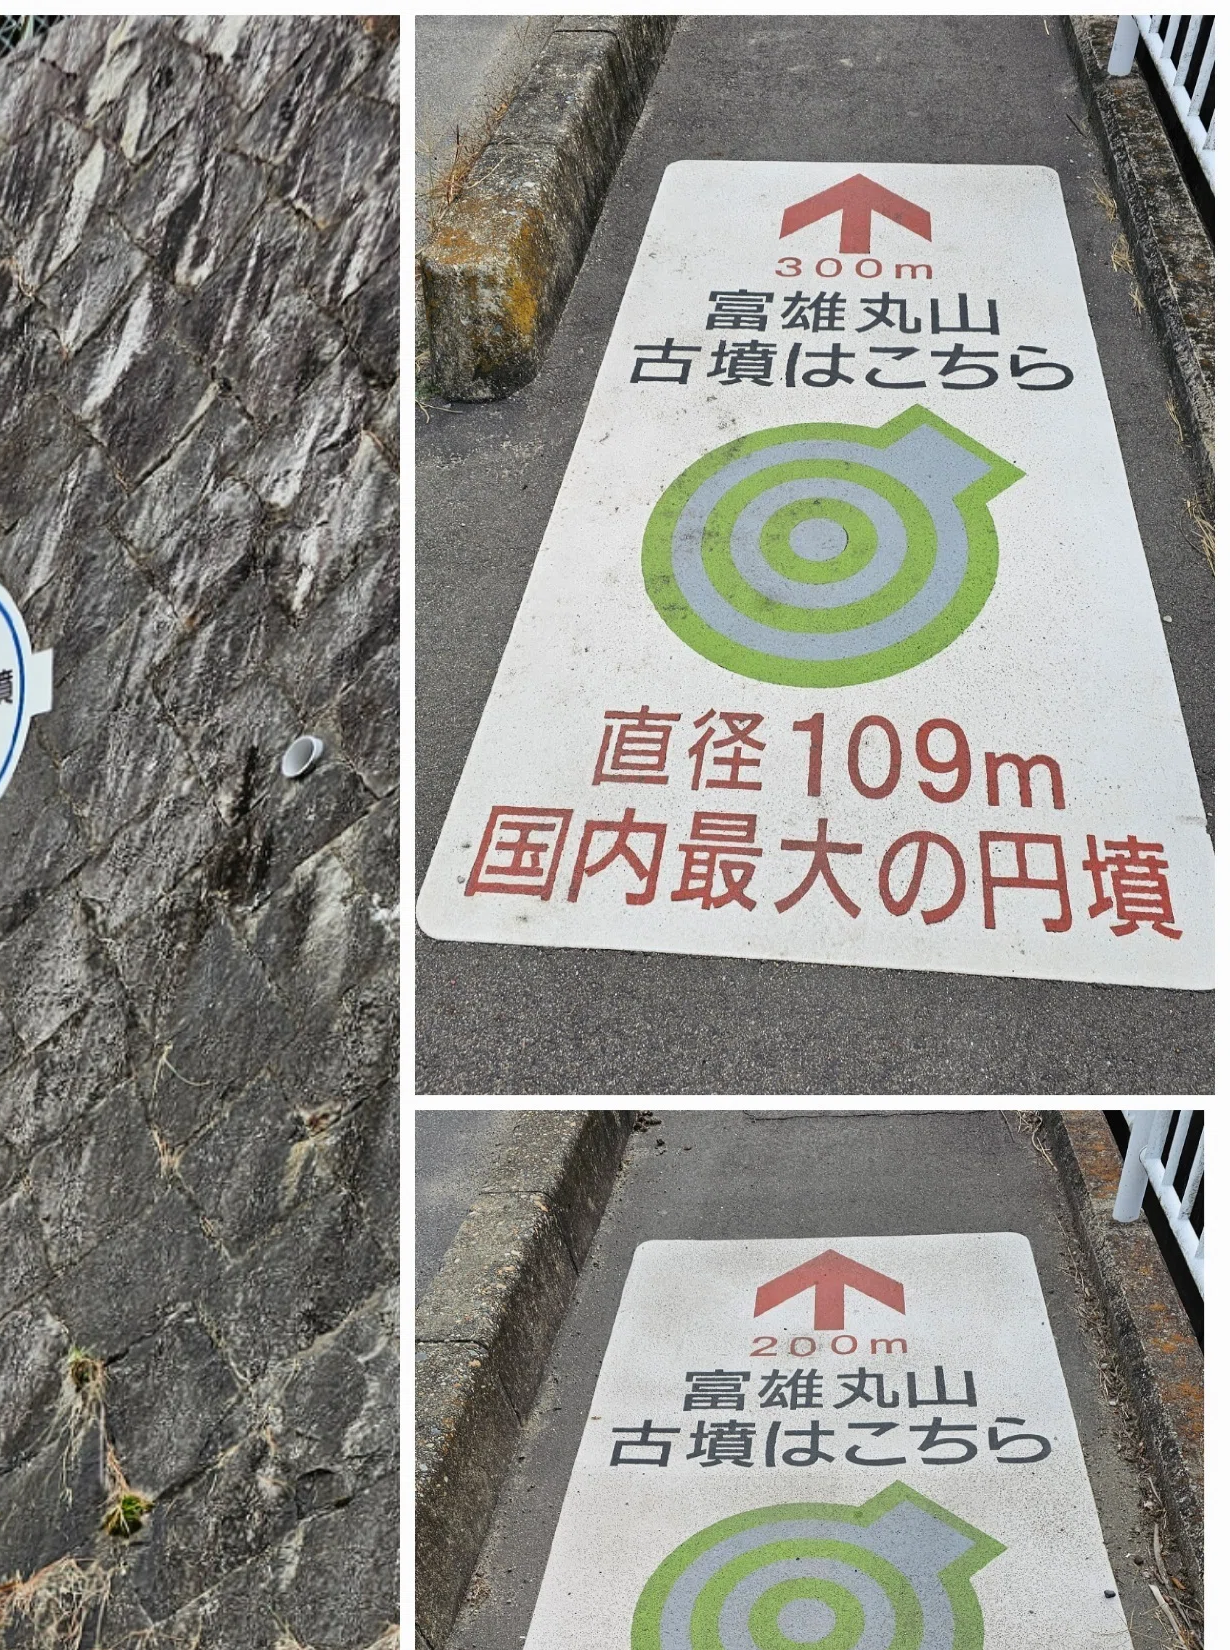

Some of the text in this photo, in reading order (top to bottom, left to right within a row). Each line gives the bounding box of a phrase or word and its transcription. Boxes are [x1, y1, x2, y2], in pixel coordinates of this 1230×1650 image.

[775, 255, 933, 281] 300m
[705, 289, 999, 336] 富雄丸山
[629, 343, 1074, 391] 古墳はこちら
[464, 805, 1183, 940] 国内最大の円墳
[750, 1334, 908, 1358] 200m
[682, 1365, 977, 1411] 富雄丸山
[609, 1416, 1052, 1468] 古墳はこちら
